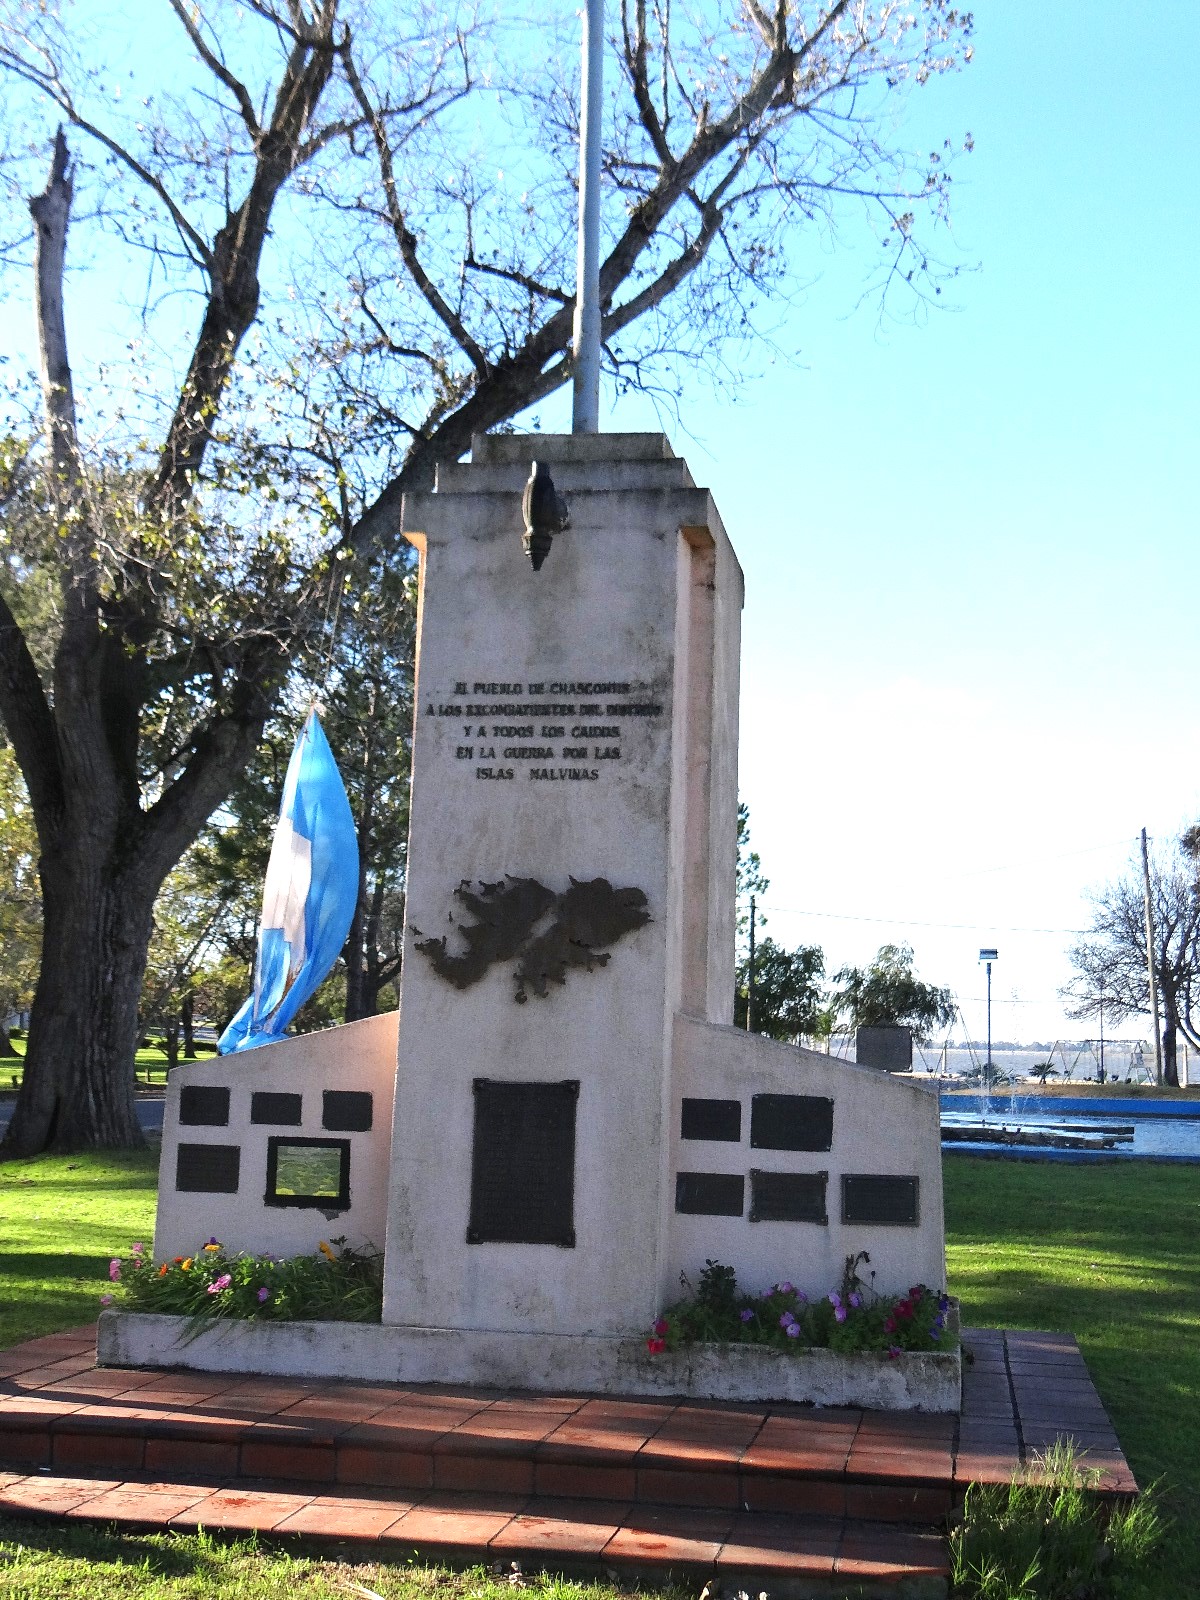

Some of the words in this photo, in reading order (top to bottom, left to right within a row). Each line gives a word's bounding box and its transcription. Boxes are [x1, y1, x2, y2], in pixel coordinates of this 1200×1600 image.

[473, 682, 522, 695] PUEBLO
[526, 683, 544, 695] DE
[425, 704, 435, 716] A
[439, 704, 462, 716] LOS
[580, 704, 603, 716] DEL
[463, 725, 472, 737] Y
[477, 726, 487, 737] A
[492, 725, 534, 738] TODOS
[542, 726, 565, 738] LOS
[571, 726, 620, 738] CAIDOS
[456, 746, 473, 759] EN
[479, 747, 496, 759] LA
[503, 747, 554, 759] GUERRA
[562, 747, 588, 759] POR
[595, 747, 621, 760] LAS
[476, 767, 513, 780] ISLAS
[530, 768, 599, 780] MALVINAS
